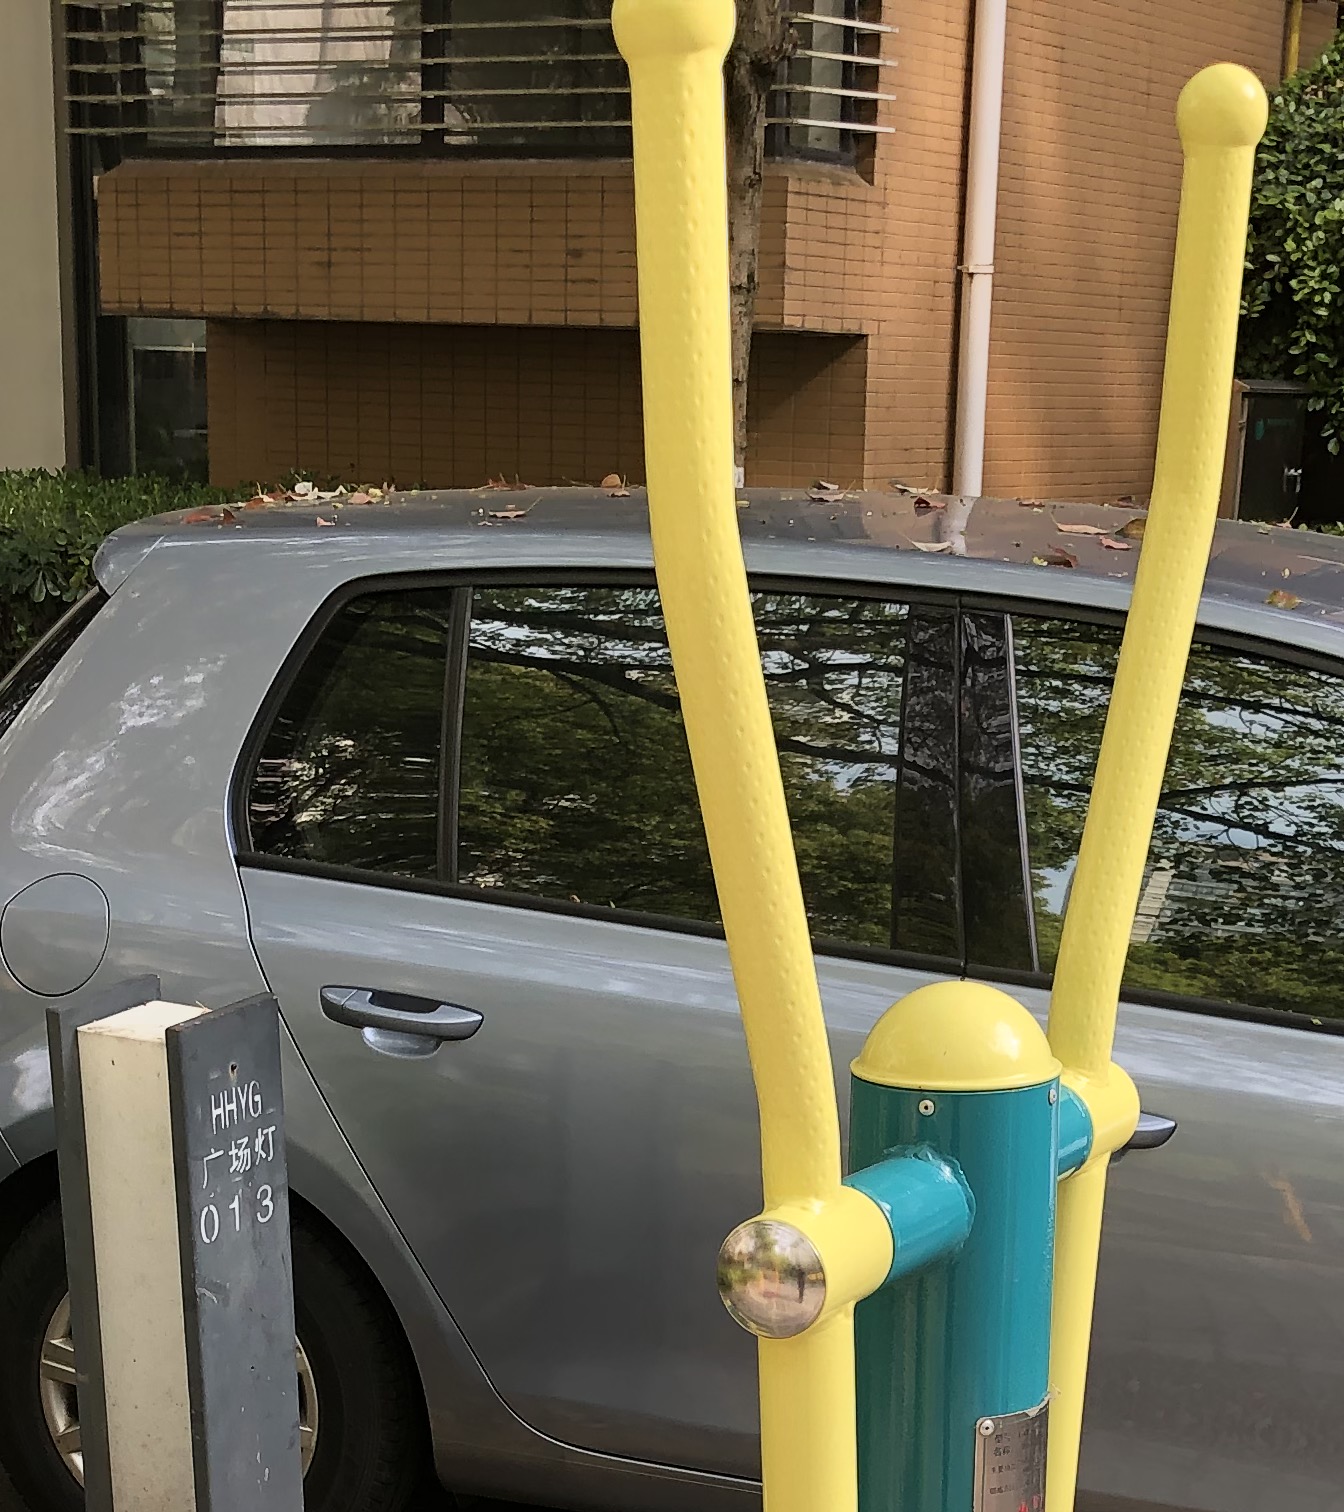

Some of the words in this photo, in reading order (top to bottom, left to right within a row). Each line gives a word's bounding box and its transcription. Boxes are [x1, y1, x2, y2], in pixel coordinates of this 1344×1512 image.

[211, 1080, 263, 1135] HHYG
[202, 1125, 276, 1189] 广场灯
[199, 1184, 274, 1244] 013
